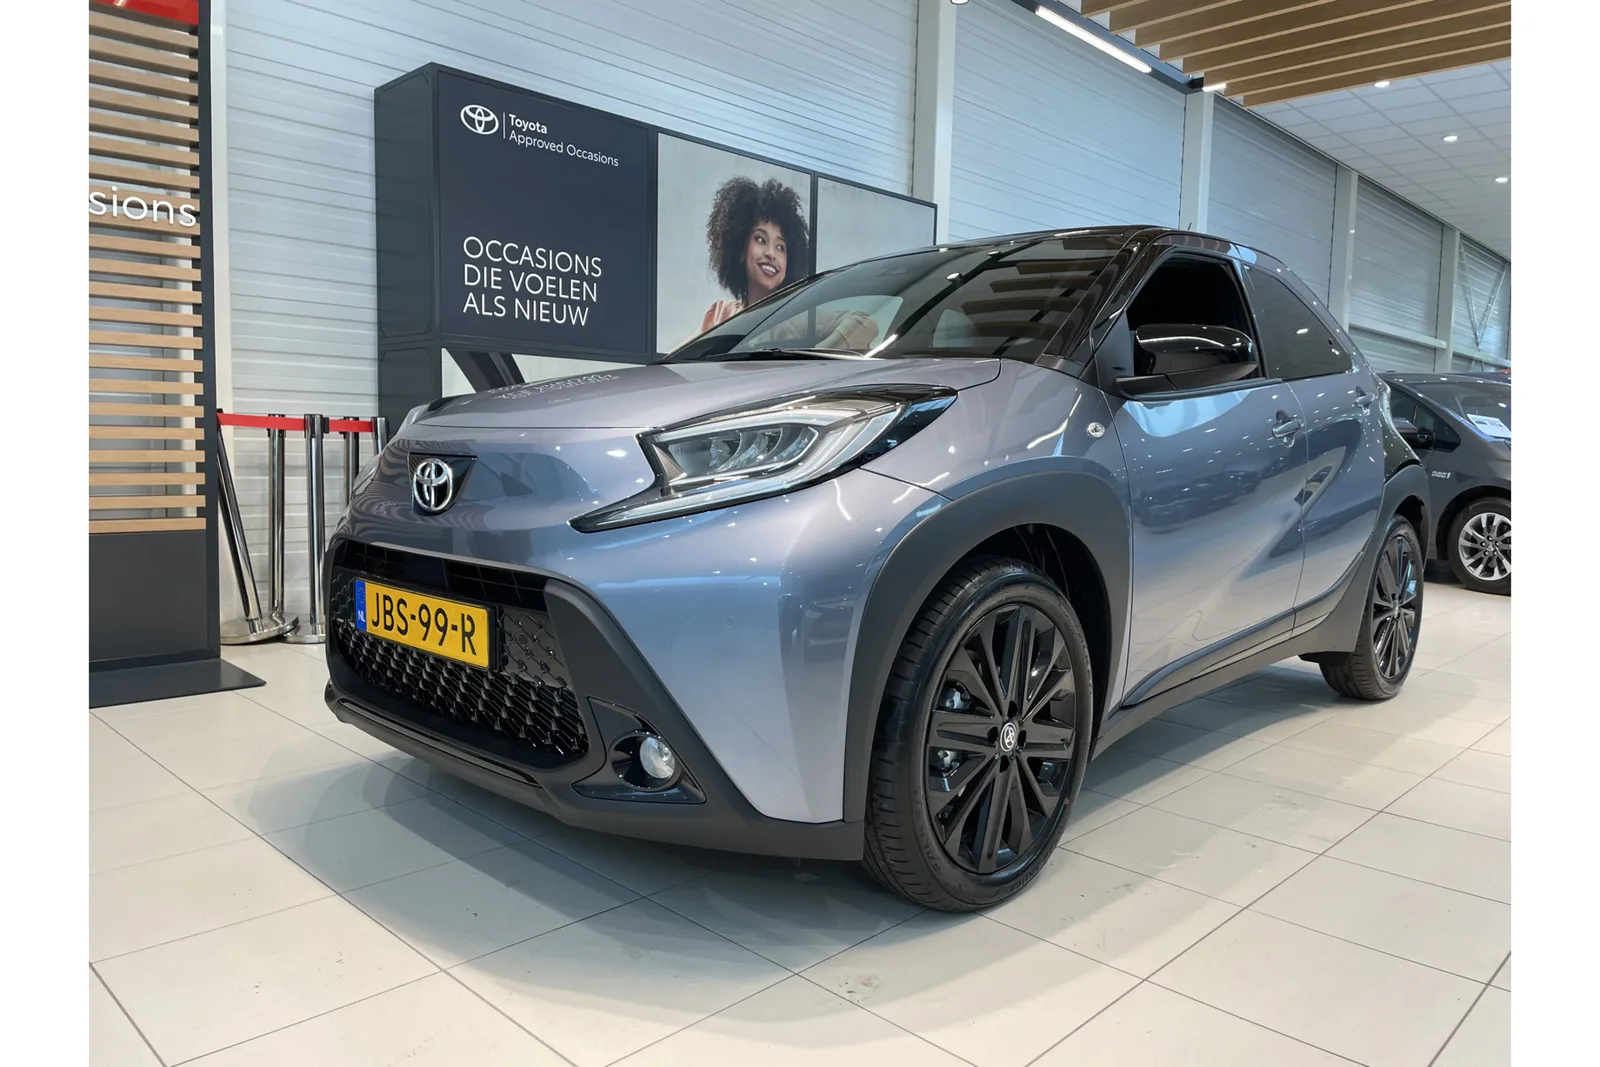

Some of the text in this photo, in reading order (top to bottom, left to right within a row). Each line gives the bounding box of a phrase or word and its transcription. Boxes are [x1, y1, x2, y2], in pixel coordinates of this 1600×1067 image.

[508, 113, 548, 135] Toyota
[509, 130, 619, 167] Approved Occasions
[89, 185, 197, 227] sions
[463, 236, 602, 278] OCCASIONS
[464, 263, 597, 302] DIE VOELEN
[463, 292, 589, 326] ALS NIEUW
[357, 609, 366, 623] NL
[371, 592, 477, 656] JBS-99-R
